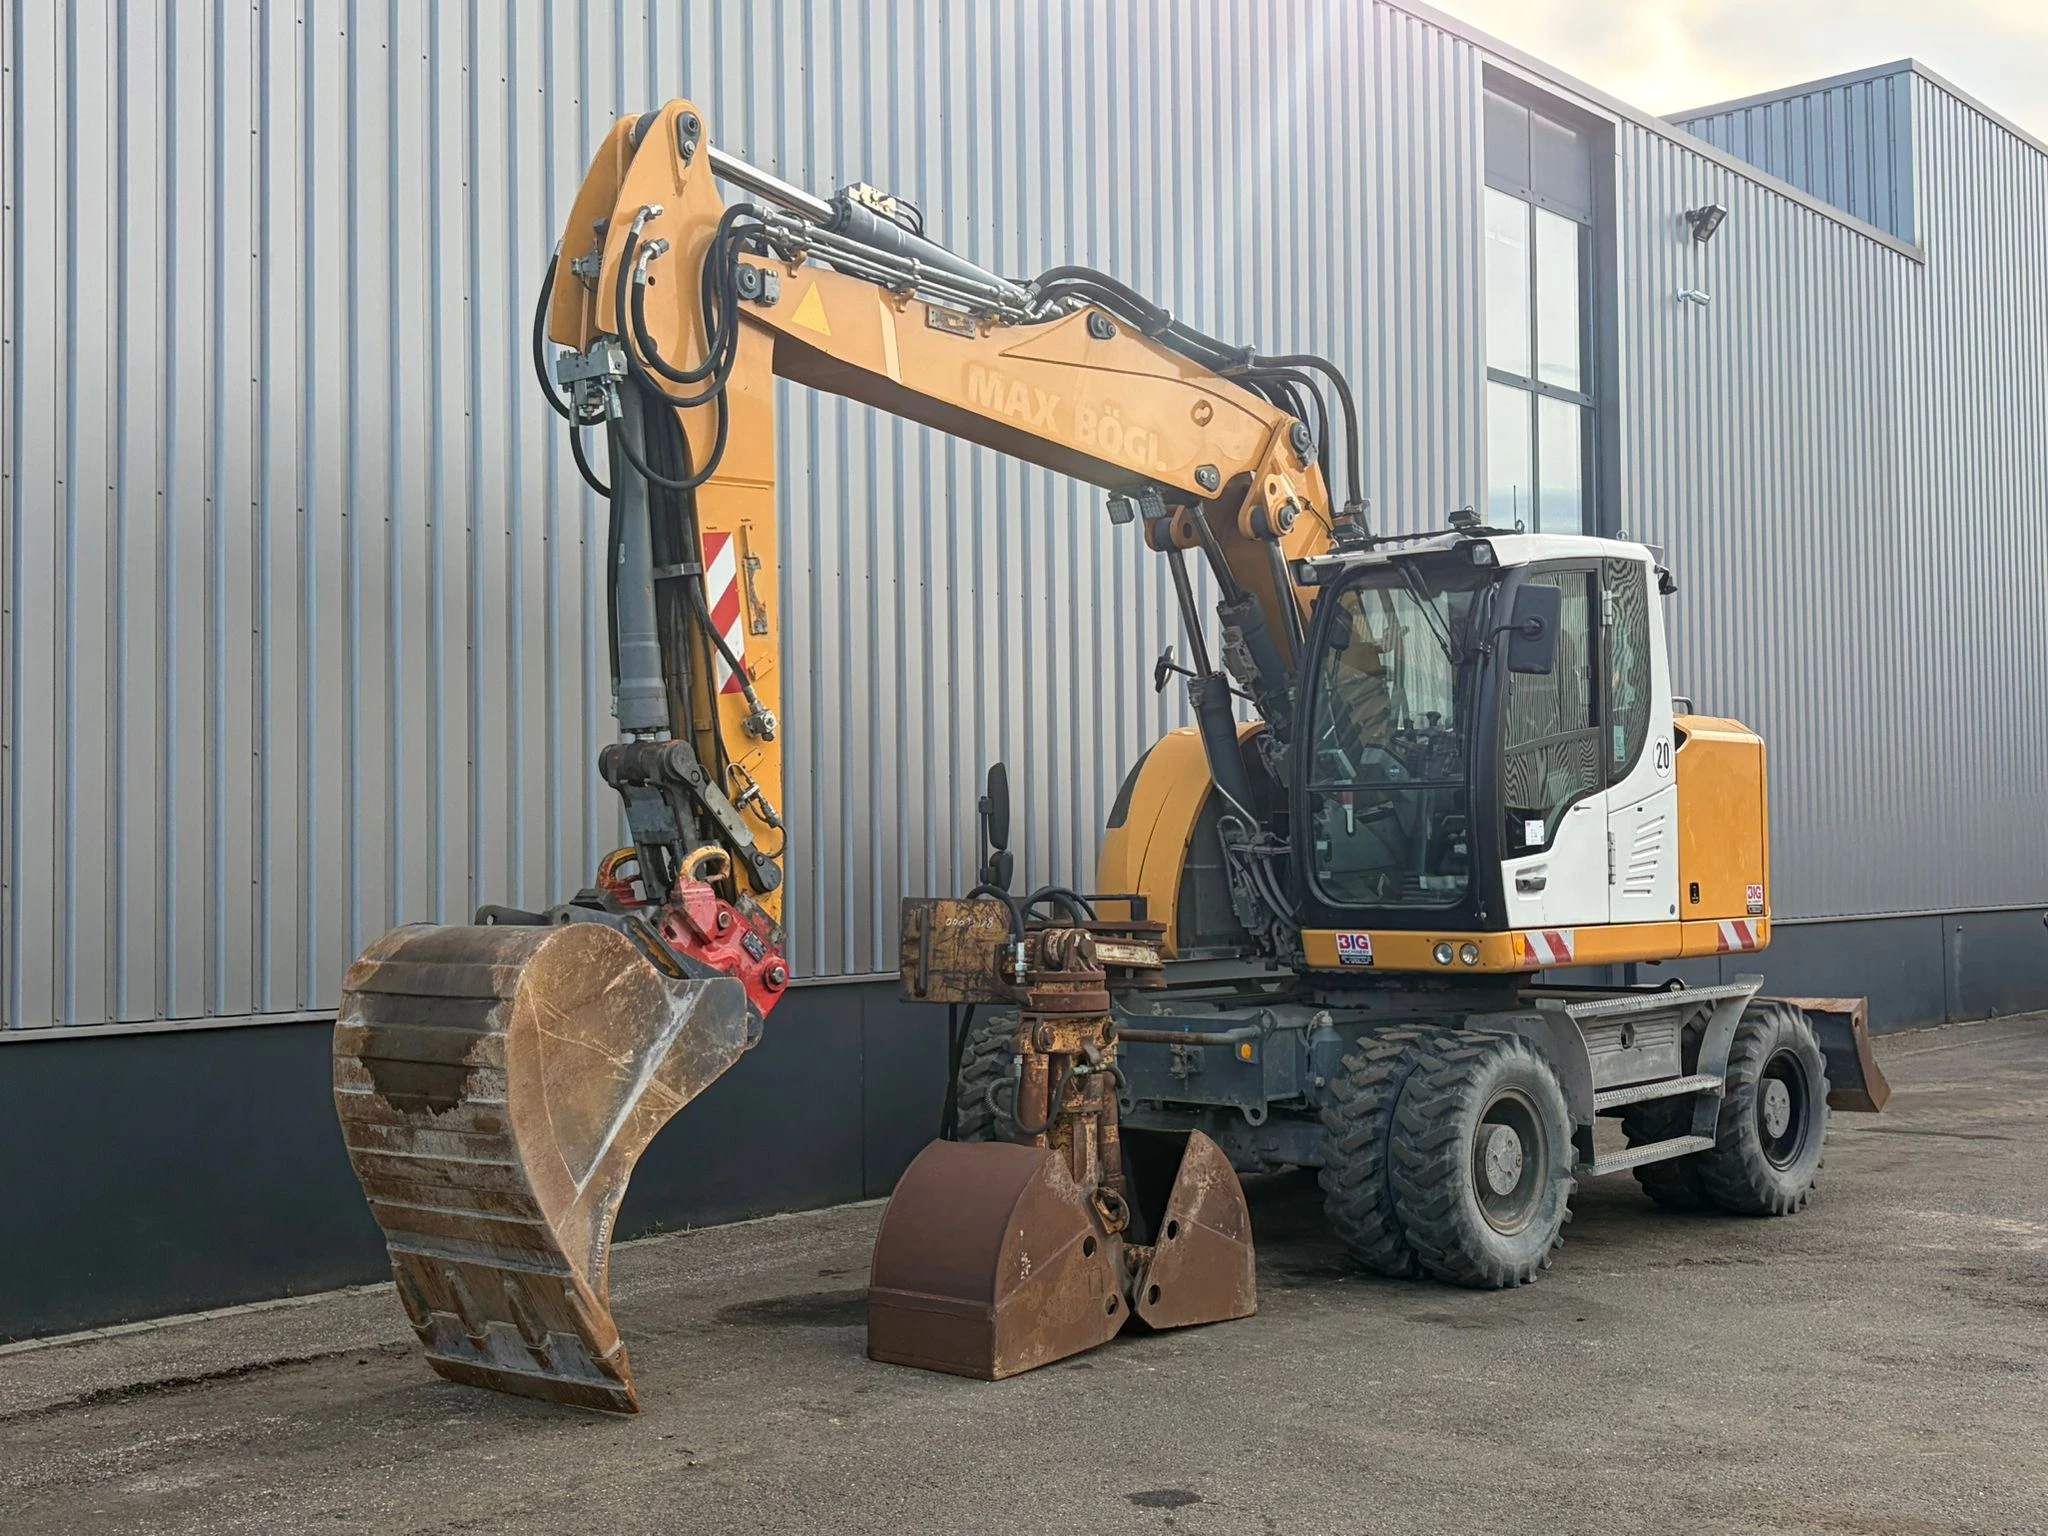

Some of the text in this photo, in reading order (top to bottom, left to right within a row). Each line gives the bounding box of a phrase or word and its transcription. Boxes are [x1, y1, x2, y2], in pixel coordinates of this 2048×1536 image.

[968, 363, 1168, 473] MAX BÖGL
[1656, 742, 1670, 769] 20
